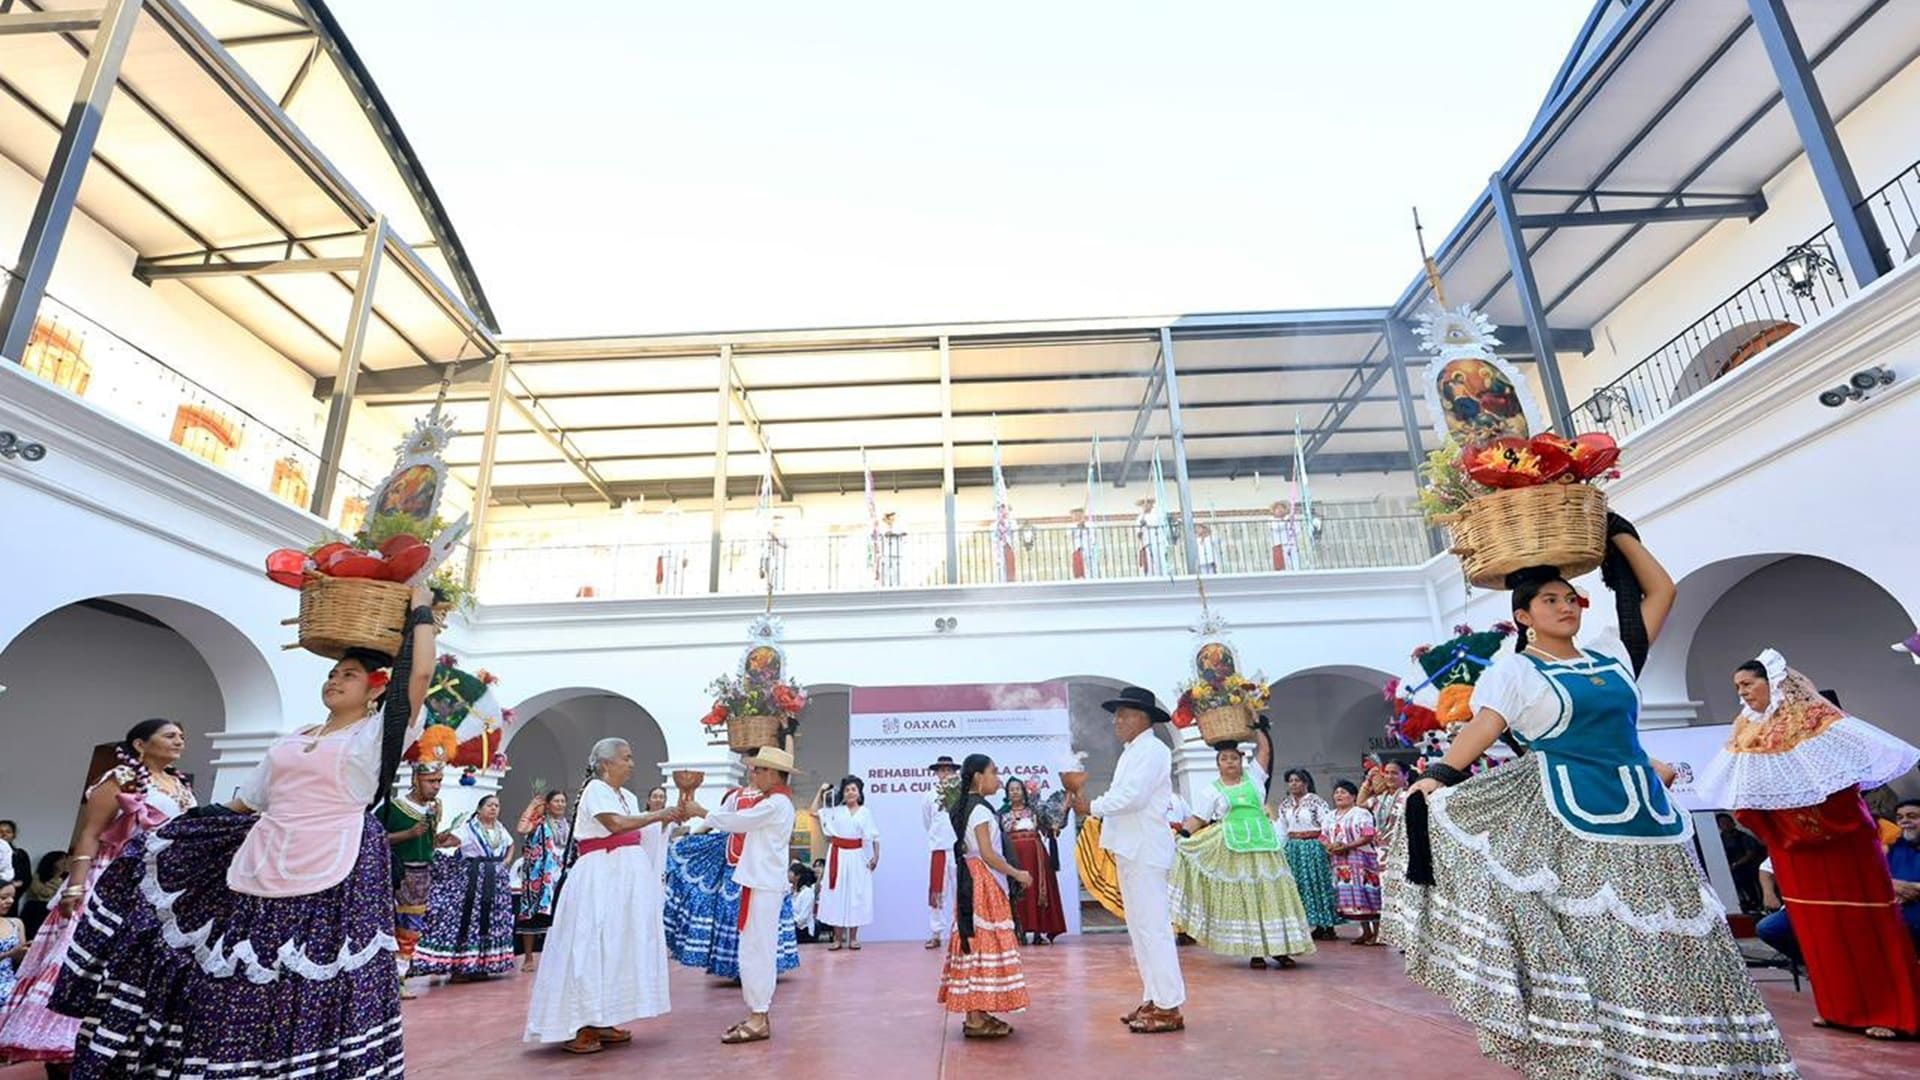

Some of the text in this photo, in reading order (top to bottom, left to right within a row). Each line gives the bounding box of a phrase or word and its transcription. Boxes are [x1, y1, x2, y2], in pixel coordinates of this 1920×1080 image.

[903, 719, 956, 730] OAXACA
[868, 767, 936, 779] REHABILIT
[1014, 765, 1049, 775] CASA
[871, 784, 888, 794] DE
[891, 783, 908, 793] LA
